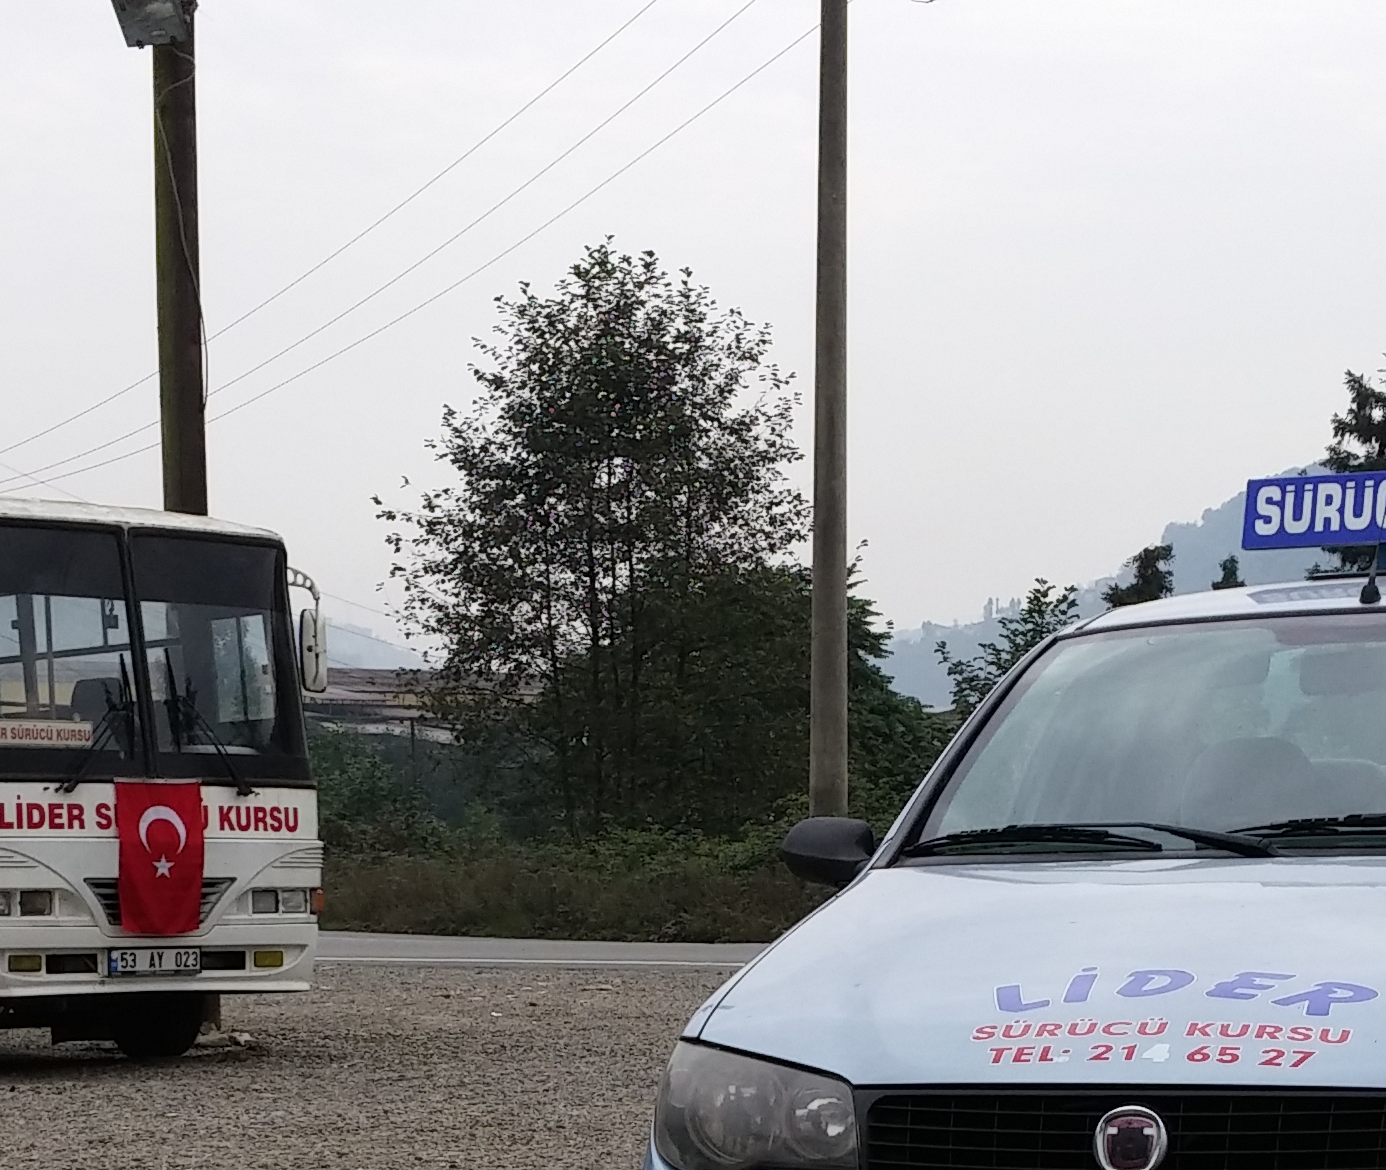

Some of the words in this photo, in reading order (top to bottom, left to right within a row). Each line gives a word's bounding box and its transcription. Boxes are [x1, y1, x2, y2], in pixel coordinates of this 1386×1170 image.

[55, 728, 91, 743] KURSU
[218, 804, 299, 833] KURSU
[120, 951, 137, 969] 53
[148, 951, 165, 969] AY
[175, 950, 199, 968] 023
[994, 966, 1380, 1017] LİDER
[971, 1017, 1170, 1042] SÜRÜCÜ
[1183, 1021, 1354, 1045] KURSU
[1085, 1043, 1171, 1063] 214
[1184, 1045, 1242, 1065] 65
[1257, 1048, 1318, 1068] 27
